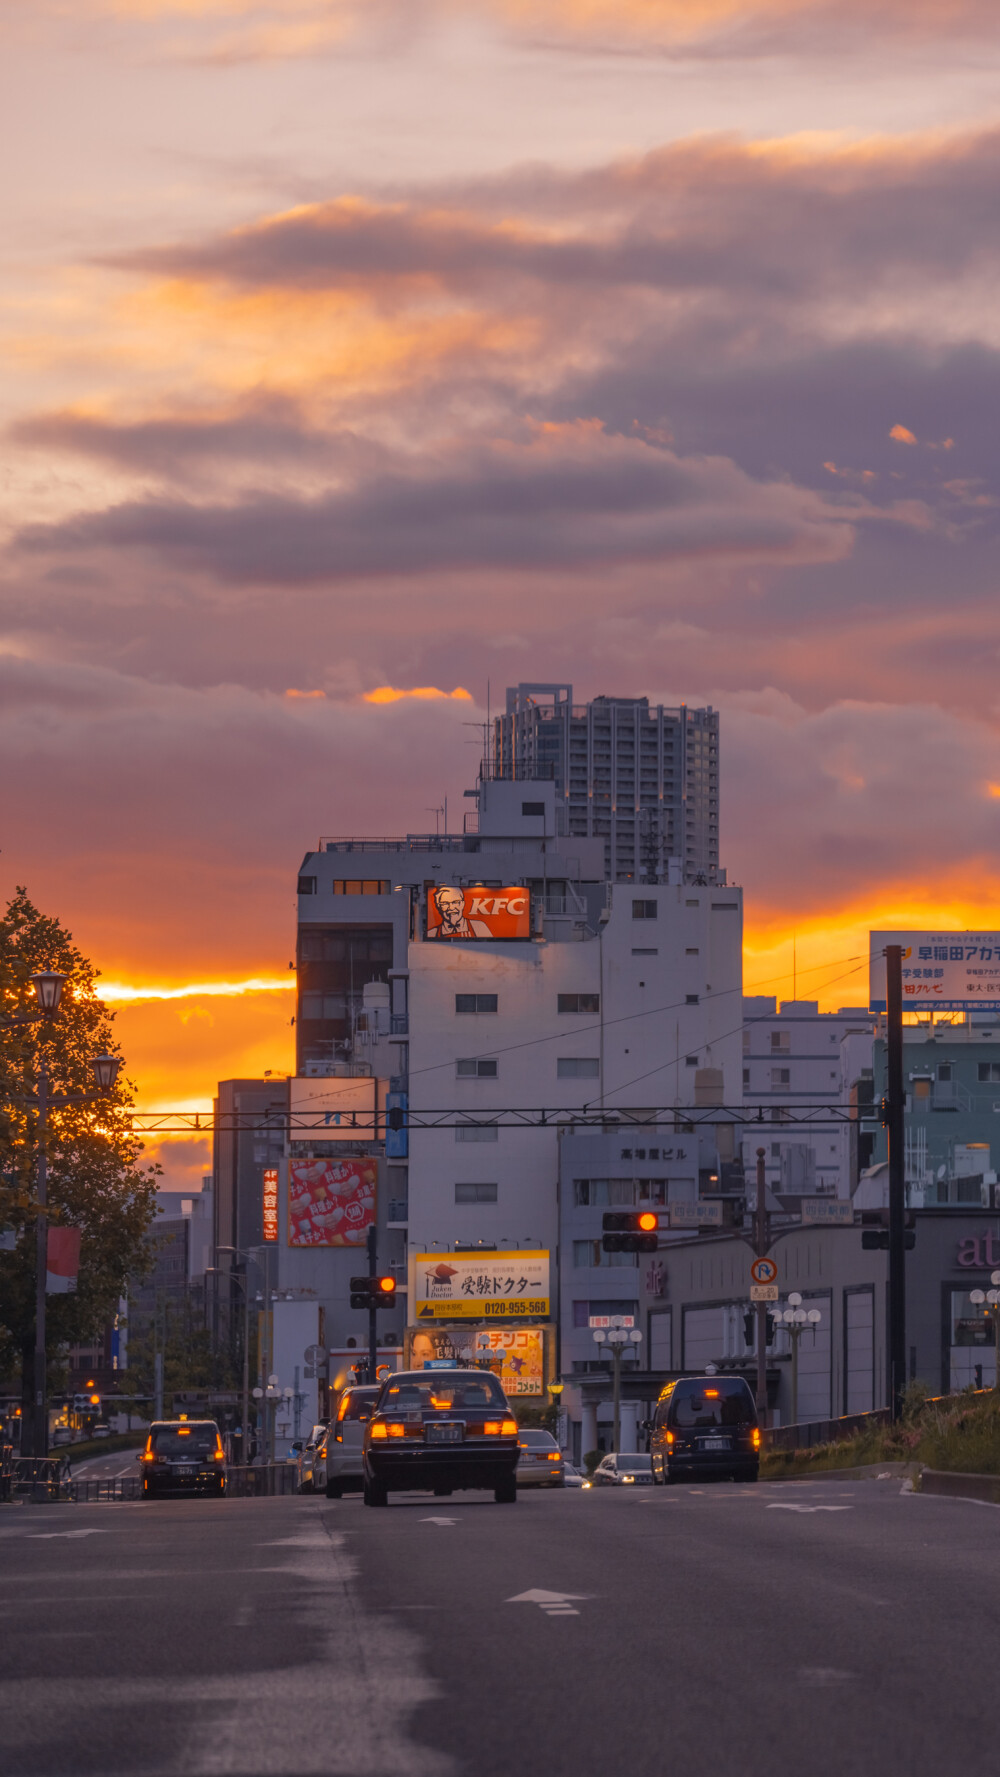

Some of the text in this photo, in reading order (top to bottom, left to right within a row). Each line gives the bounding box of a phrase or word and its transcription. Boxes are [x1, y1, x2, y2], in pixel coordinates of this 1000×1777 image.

[468, 898, 526, 915] KFC
[264, 1170, 278, 1178] 4F
[263, 1180, 278, 1222] 美容室
[431, 1285, 452, 1293] Juken
[461, 1275, 542, 1295] 受験ドクター
[484, 1301, 546, 1314] 0120-955-568
[517, 1381, 540, 1393] コメット
